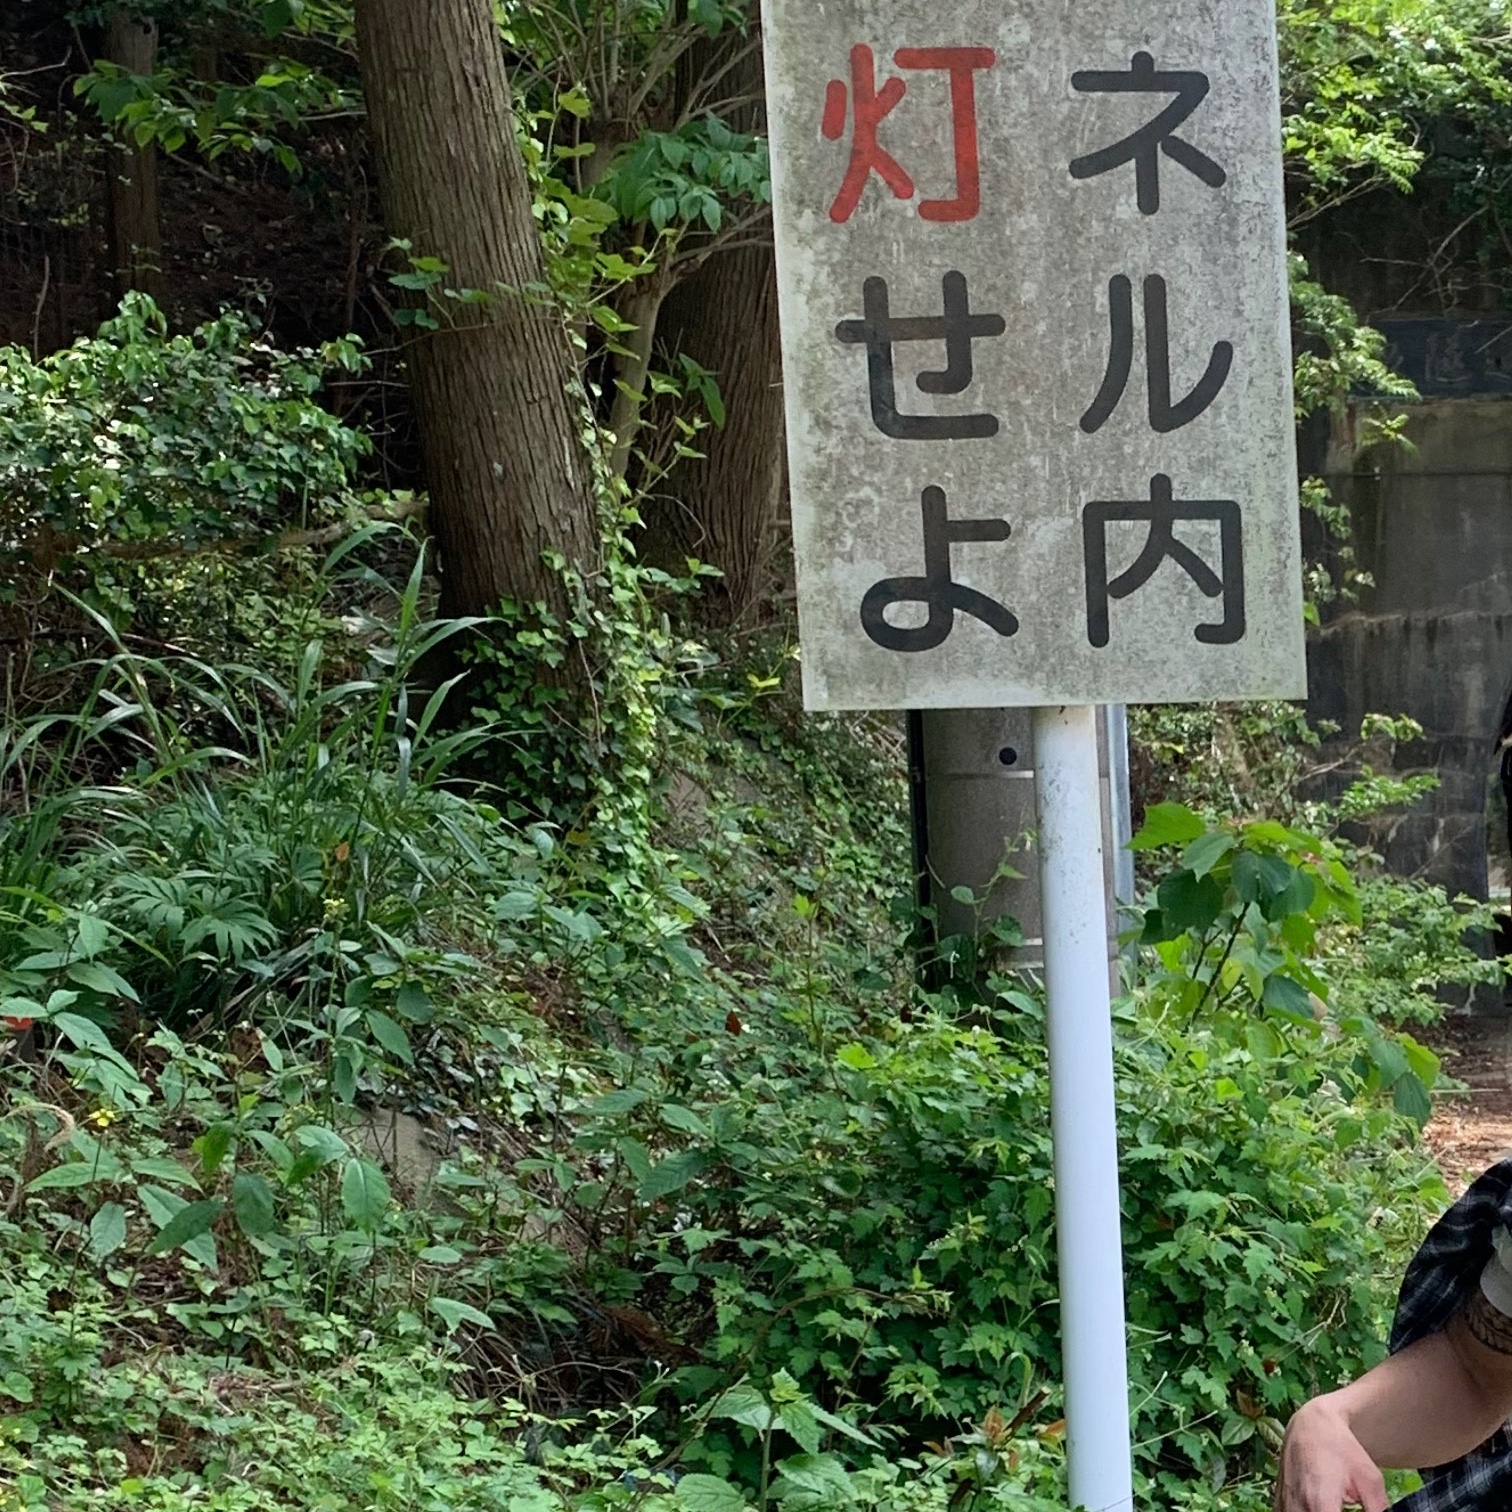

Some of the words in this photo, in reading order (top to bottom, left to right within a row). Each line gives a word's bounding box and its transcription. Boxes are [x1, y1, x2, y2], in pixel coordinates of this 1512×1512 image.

[822, 44, 1019, 653] 灯せよ
[1069, 51, 1246, 648] ネル内
